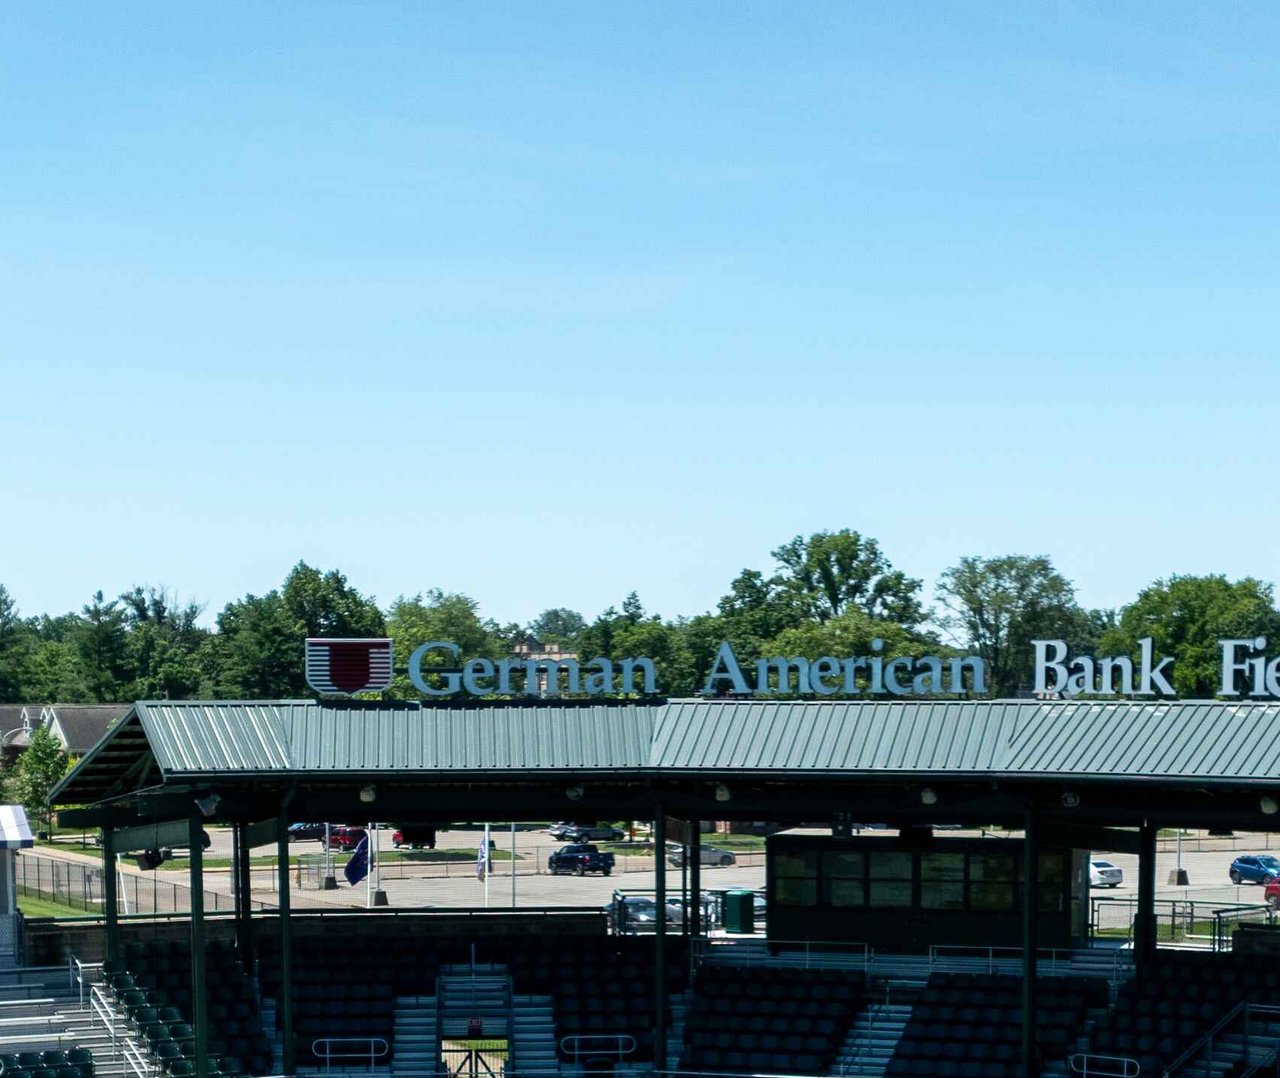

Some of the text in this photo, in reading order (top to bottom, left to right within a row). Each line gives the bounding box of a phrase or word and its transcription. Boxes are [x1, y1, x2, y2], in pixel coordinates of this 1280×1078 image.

[408, 641, 660, 697] German
[703, 640, 989, 696] American
[1031, 637, 1177, 698] Bank
